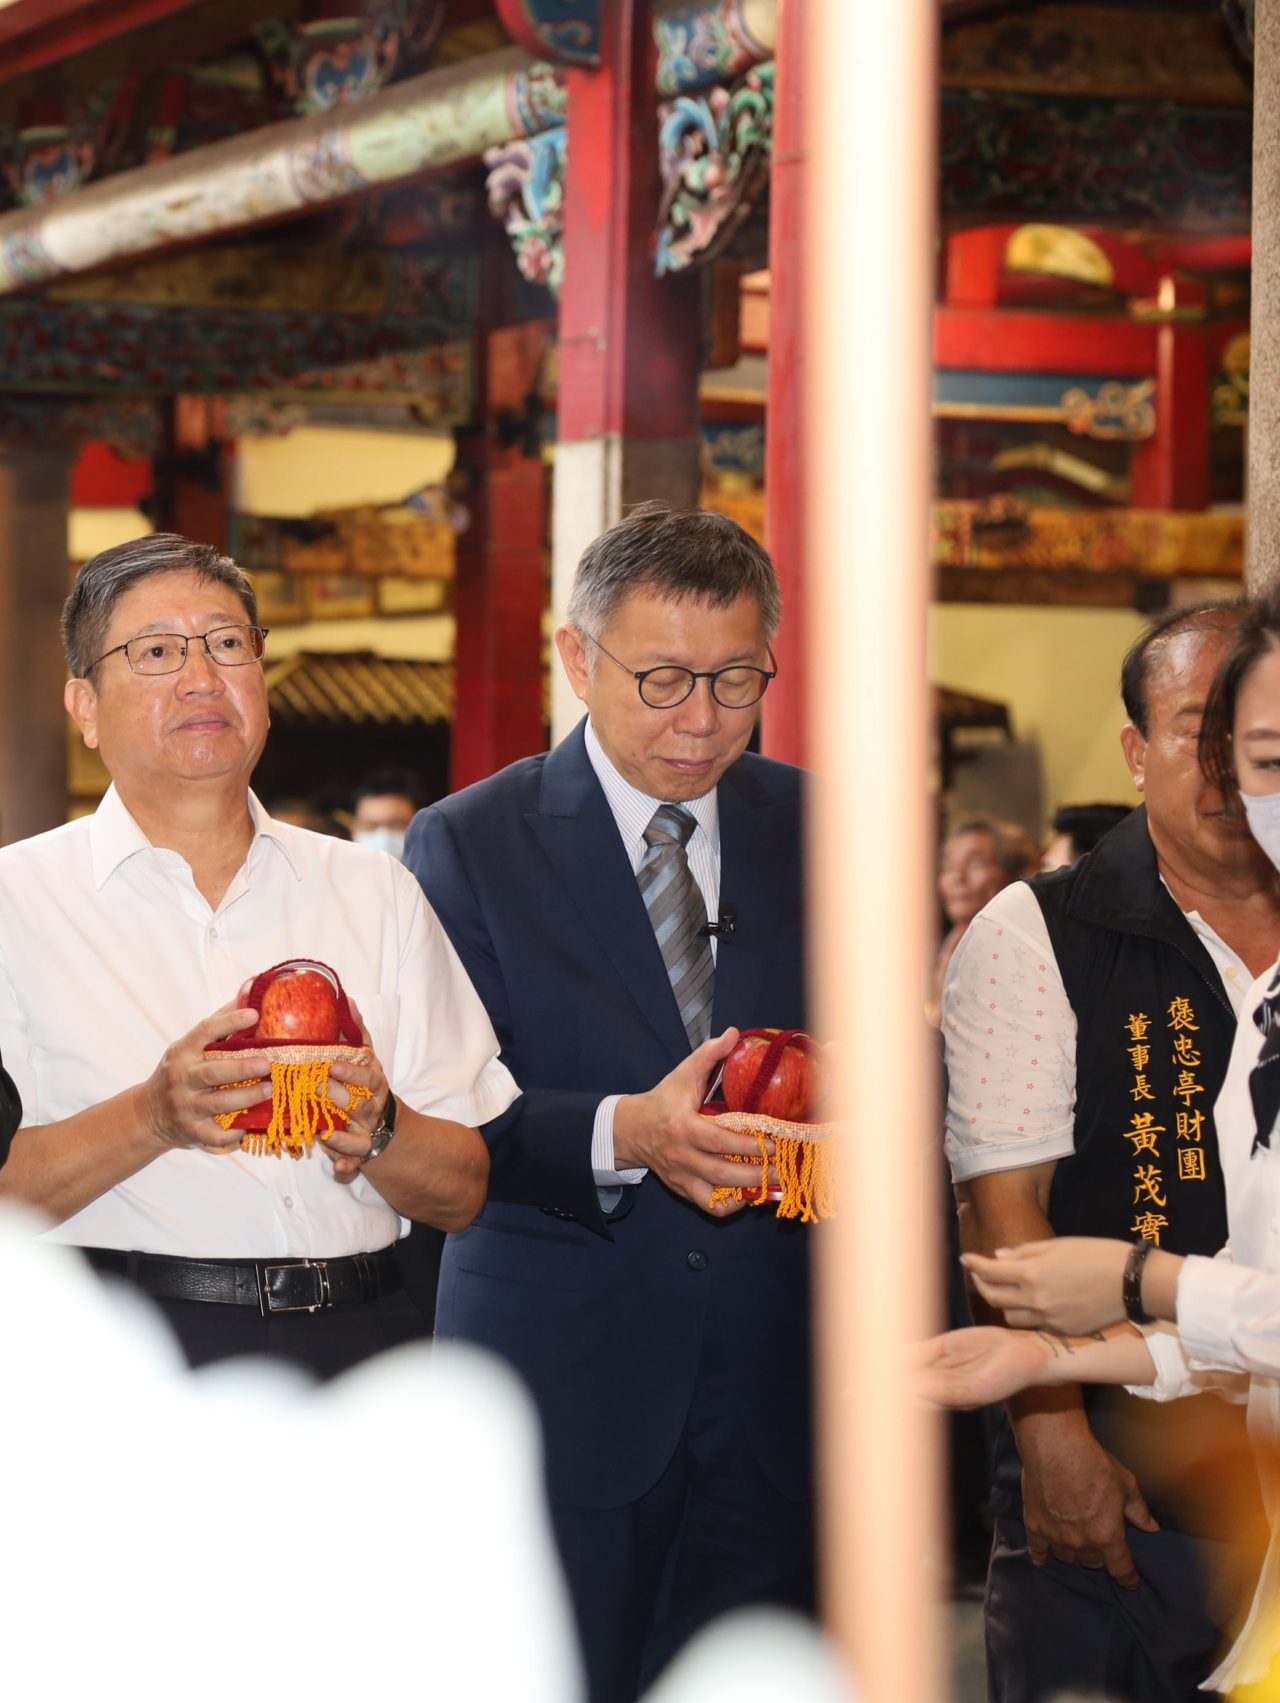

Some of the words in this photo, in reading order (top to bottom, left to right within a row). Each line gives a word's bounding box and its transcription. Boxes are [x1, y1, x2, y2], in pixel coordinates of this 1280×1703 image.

[1167, 996, 1206, 1181] 褒忠亭財團
